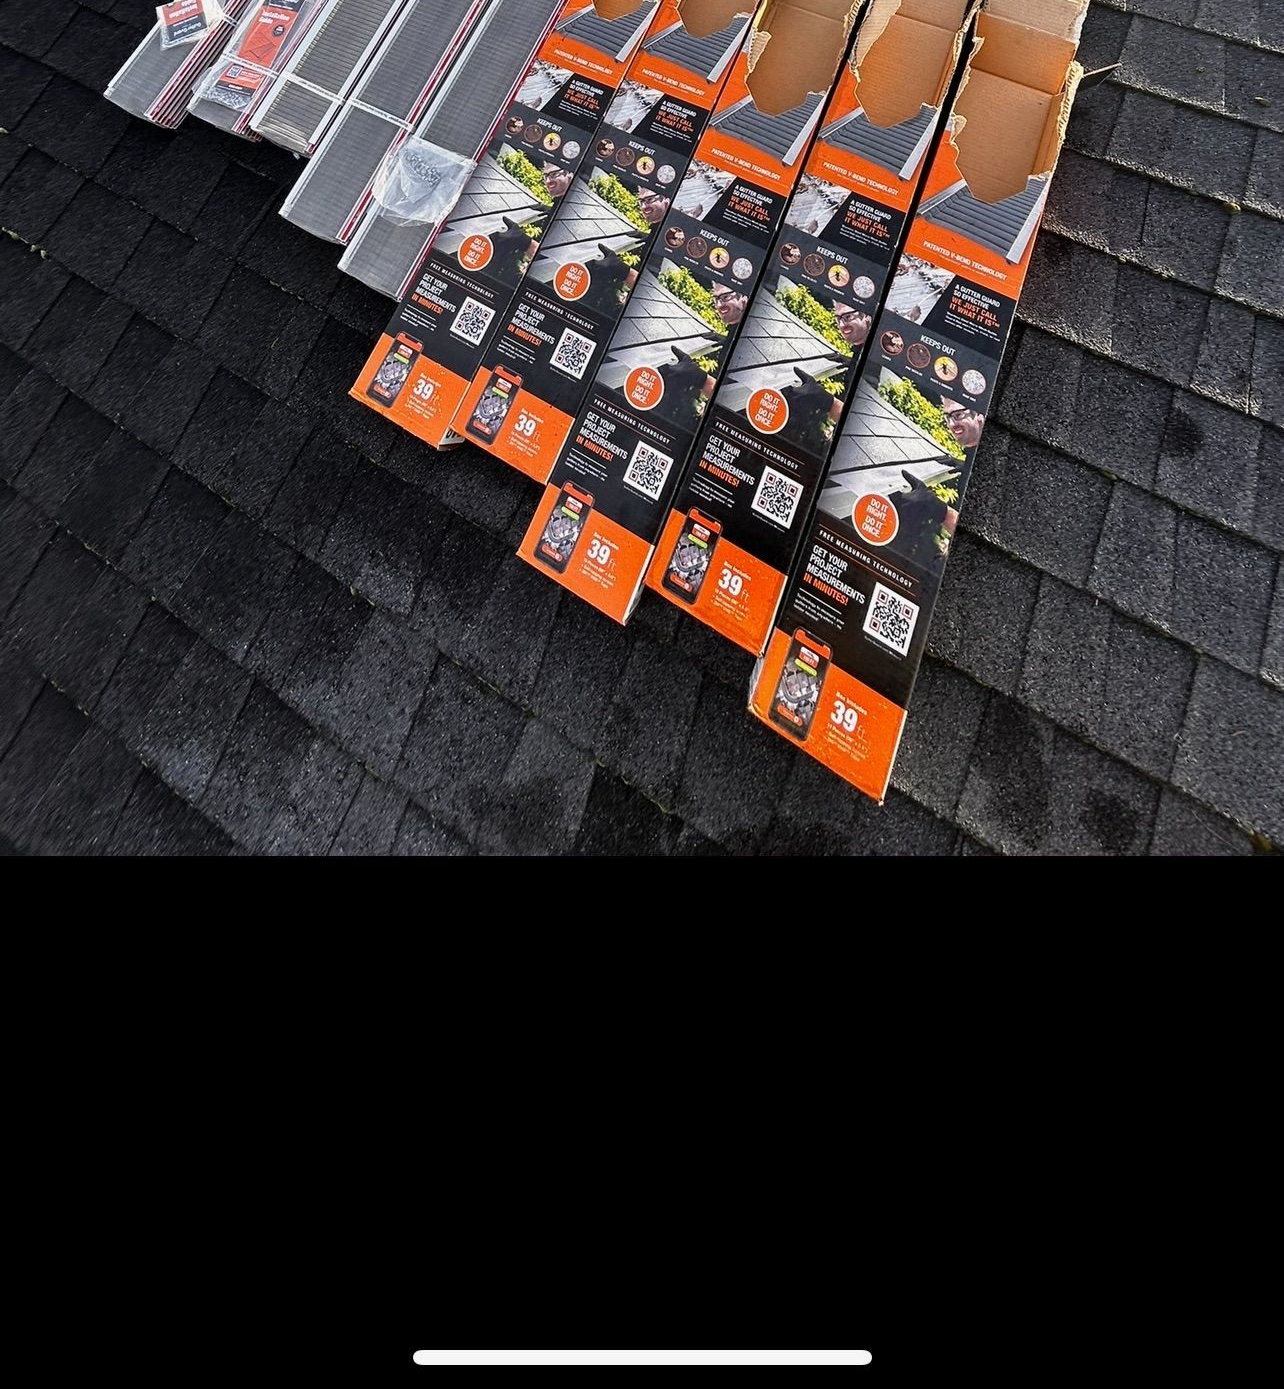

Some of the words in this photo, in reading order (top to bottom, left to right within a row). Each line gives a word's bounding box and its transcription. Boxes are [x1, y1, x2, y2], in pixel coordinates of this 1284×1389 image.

[536, 118, 552, 128] KEEPS
[551, 124, 562, 132] OUT
[628, 140, 645, 151] KEEPS
[644, 147, 655, 155] OUT
[730, 195, 740, 203] WE
[740, 199, 754, 209] JUST
[754, 205, 769, 215] CALL
[739, 186, 757, 197] GUTTER
[756, 193, 773, 203] GUARD
[739, 192, 763, 206] EFFECTIVE
[734, 203, 751, 214] WHAT
[848, 204, 856, 212] SO
[856, 208, 882, 222] EFFECTIVE
[855, 201, 874, 212] GUTTER
[874, 208, 892, 219] GUARD
[846, 210, 857, 219] WE
[856, 215, 872, 225] JUST
[873, 221, 889, 232] CALL
[851, 219, 869, 231] WHAT
[473, 237, 482, 245] DO
[699, 229, 718, 241] KEEPS
[717, 237, 729, 247] OUT
[467, 249, 475, 257] DO
[816, 246, 835, 258] KEEPS
[835, 254, 848, 264] OUT
[922, 240, 950, 257] PATENTED
[949, 252, 971, 266] V-BEND
[971, 261, 1007, 280] TECHNOLOGY
[569, 265, 578, 273] DO
[418, 279, 442, 296] PROJECT
[422, 273, 435, 283] GET
[432, 278, 448, 290] YOUR
[429, 262, 441, 271] FREE
[440, 268, 466, 284] MEASURING
[466, 281, 494, 298] TECHNOLOGY
[563, 278, 571, 286] DO
[411, 293, 419, 301] IN
[417, 296, 444, 314] MINUTES!
[414, 286, 457, 312] MEASUREMENTS
[952, 289, 961, 297] SO
[961, 293, 989, 309] EFFECTIVE
[960, 285, 981, 299] GUTTER
[981, 294, 1000, 307] GUARD
[514, 309, 540, 327] PROJECT
[517, 302, 530, 313] GET
[528, 308, 545, 321] YOUR
[524, 291, 537, 300] FREE
[536, 297, 564, 314] MEASURING
[564, 311, 594, 330] TECHNOLOGY
[948, 302, 955, 310] IT
[956, 306, 976, 319] WHAT
[976, 314, 983, 322] IT
[950, 296, 962, 305] WE
[962, 301, 979, 313] JUST
[980, 309, 997, 321] CALL
[507, 323, 515, 332] IN
[513, 327, 542, 346] MINUTES!
[510, 316, 556, 344] MEASUREMENTS
[920, 334, 941, 349] KEEPS
[941, 344, 955, 356] OUT
[640, 370, 650, 379] DO
[649, 374, 656, 382] IT
[411, 378, 435, 401] 39
[634, 384, 643, 393] DO
[642, 388, 650, 396] IT
[763, 392, 773, 401] DO
[772, 396, 779, 405] IT
[585, 410, 600, 423] GET
[598, 417, 616, 432] YOUR
[593, 398, 606, 409] FREE
[606, 406, 637, 426] MEASURING
[636, 422, 670, 444] TECHNOLOGY
[757, 406, 767, 416] DO
[766, 411, 774, 420] IT
[513, 413, 538, 438] 39
[582, 418, 610, 439] PROJECT
[575, 434, 584, 444] IN
[582, 439, 614, 461] MINUTES!
[578, 426, 629, 459] MEASUREMENTS
[705, 442, 735, 463] PROJECT
[708, 434, 723, 447] GET
[721, 441, 741, 457] YOUR
[714, 421, 729, 432] FREE
[729, 429, 762, 450] MEASURING
[762, 447, 798, 470] TECHNOLOGY
[698, 458, 707, 469] IN
[706, 463, 740, 487] MINUTES!
[701, 450, 756, 485] MEASUREMENTS
[870, 497, 881, 509] DO
[880, 503, 888, 513] IT
[864, 514, 875, 525] DO
[875, 520, 883, 530] IT
[585, 537, 612, 567] 39
[812, 544, 828, 560] GET
[827, 552, 848, 571] YOUR
[818, 529, 834, 542] FREE
[835, 539, 871, 564] MEASURING
[872, 560, 912, 588] TECHNOLOGY
[809, 553, 842, 579] PROJECT
[716, 567, 744, 598] 39
[802, 572, 812, 584] IN
[811, 578, 849, 606] MINUTES!
[805, 562, 866, 604] MEASUREMENTS
[828, 698, 859, 734] 39
